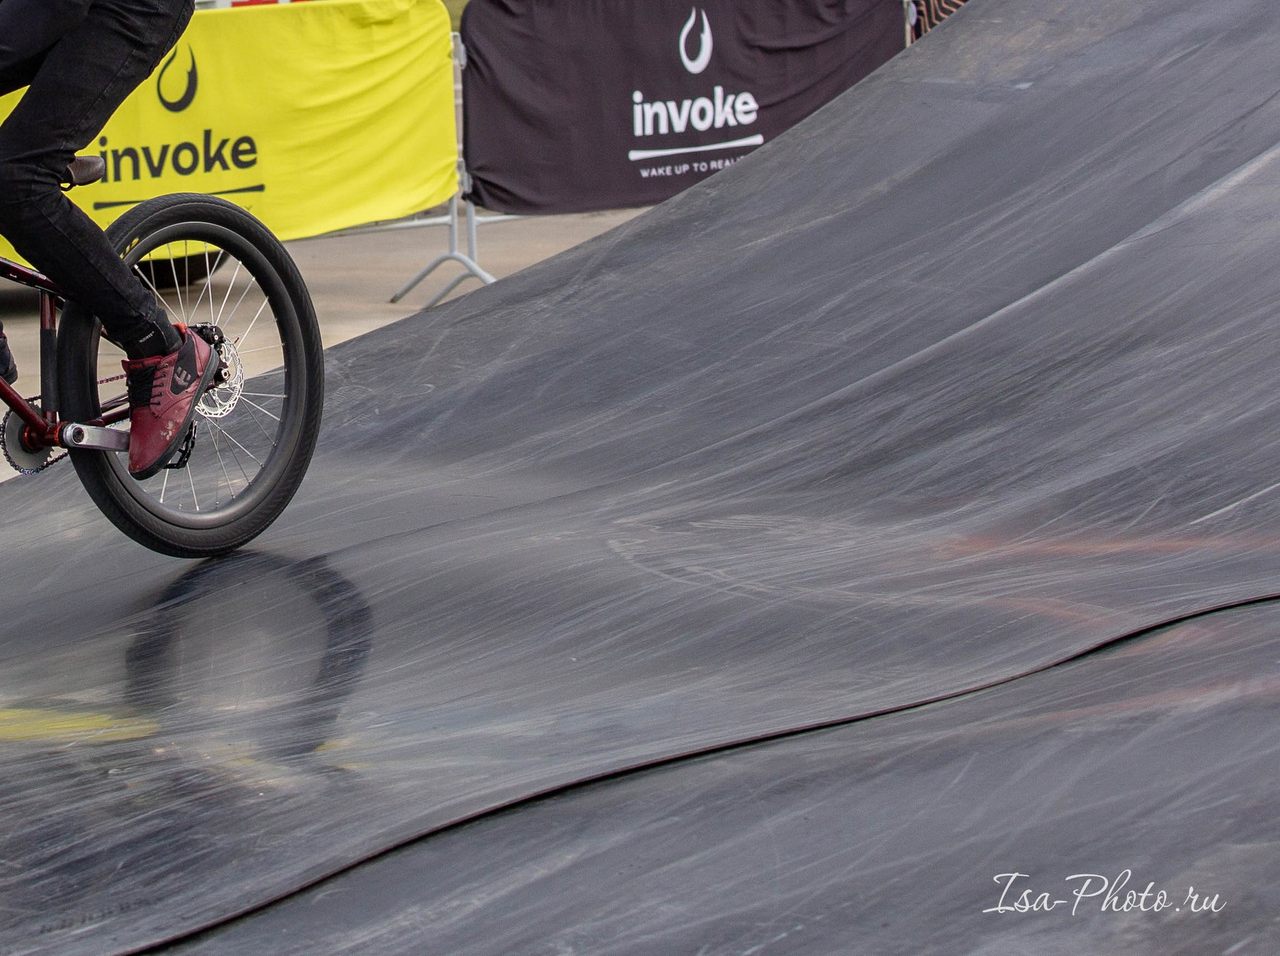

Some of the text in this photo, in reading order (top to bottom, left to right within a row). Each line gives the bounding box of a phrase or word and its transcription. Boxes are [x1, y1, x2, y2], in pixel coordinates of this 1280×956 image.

[632, 85, 759, 137] invoke
[99, 129, 257, 183] invoke
[640, 166, 672, 178] WAKE
[675, 163, 690, 174] UP
[693, 160, 708, 172] TO
